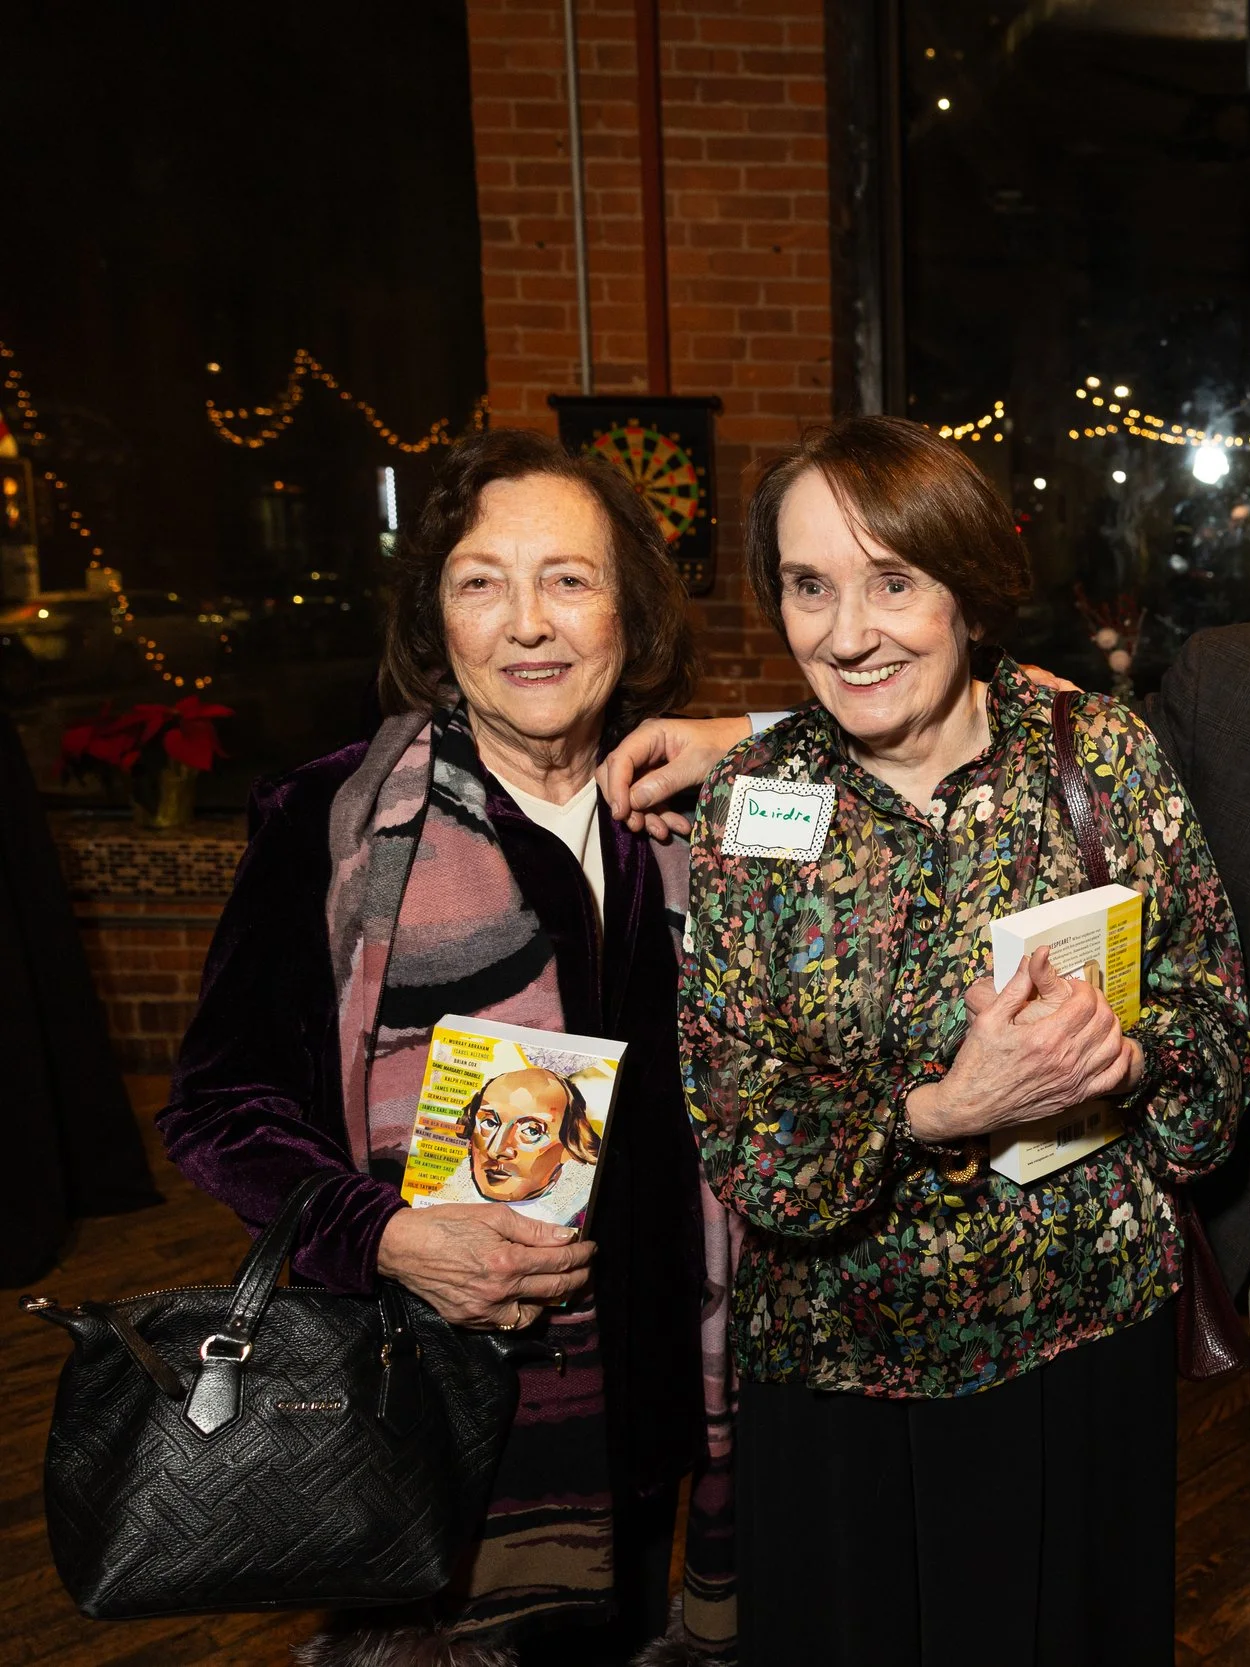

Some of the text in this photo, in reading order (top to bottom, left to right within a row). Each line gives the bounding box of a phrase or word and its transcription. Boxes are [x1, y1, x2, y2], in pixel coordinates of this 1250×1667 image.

[749, 798, 811, 823] Deirdre
[468, 1043, 489, 1051] ABRAHAM
[432, 1062, 442, 1070] DAME
[443, 1064, 463, 1075] MARGARET
[460, 1079, 478, 1087] FIENNES
[428, 1093, 449, 1101] GERMAINE
[415, 1129, 431, 1137] MAXINE
[445, 1136, 467, 1146] KINGSTON
[434, 1145, 447, 1153] CAROL
[424, 1152, 442, 1160] CAMILLE
[422, 1161, 442, 1170] ANTHONY
